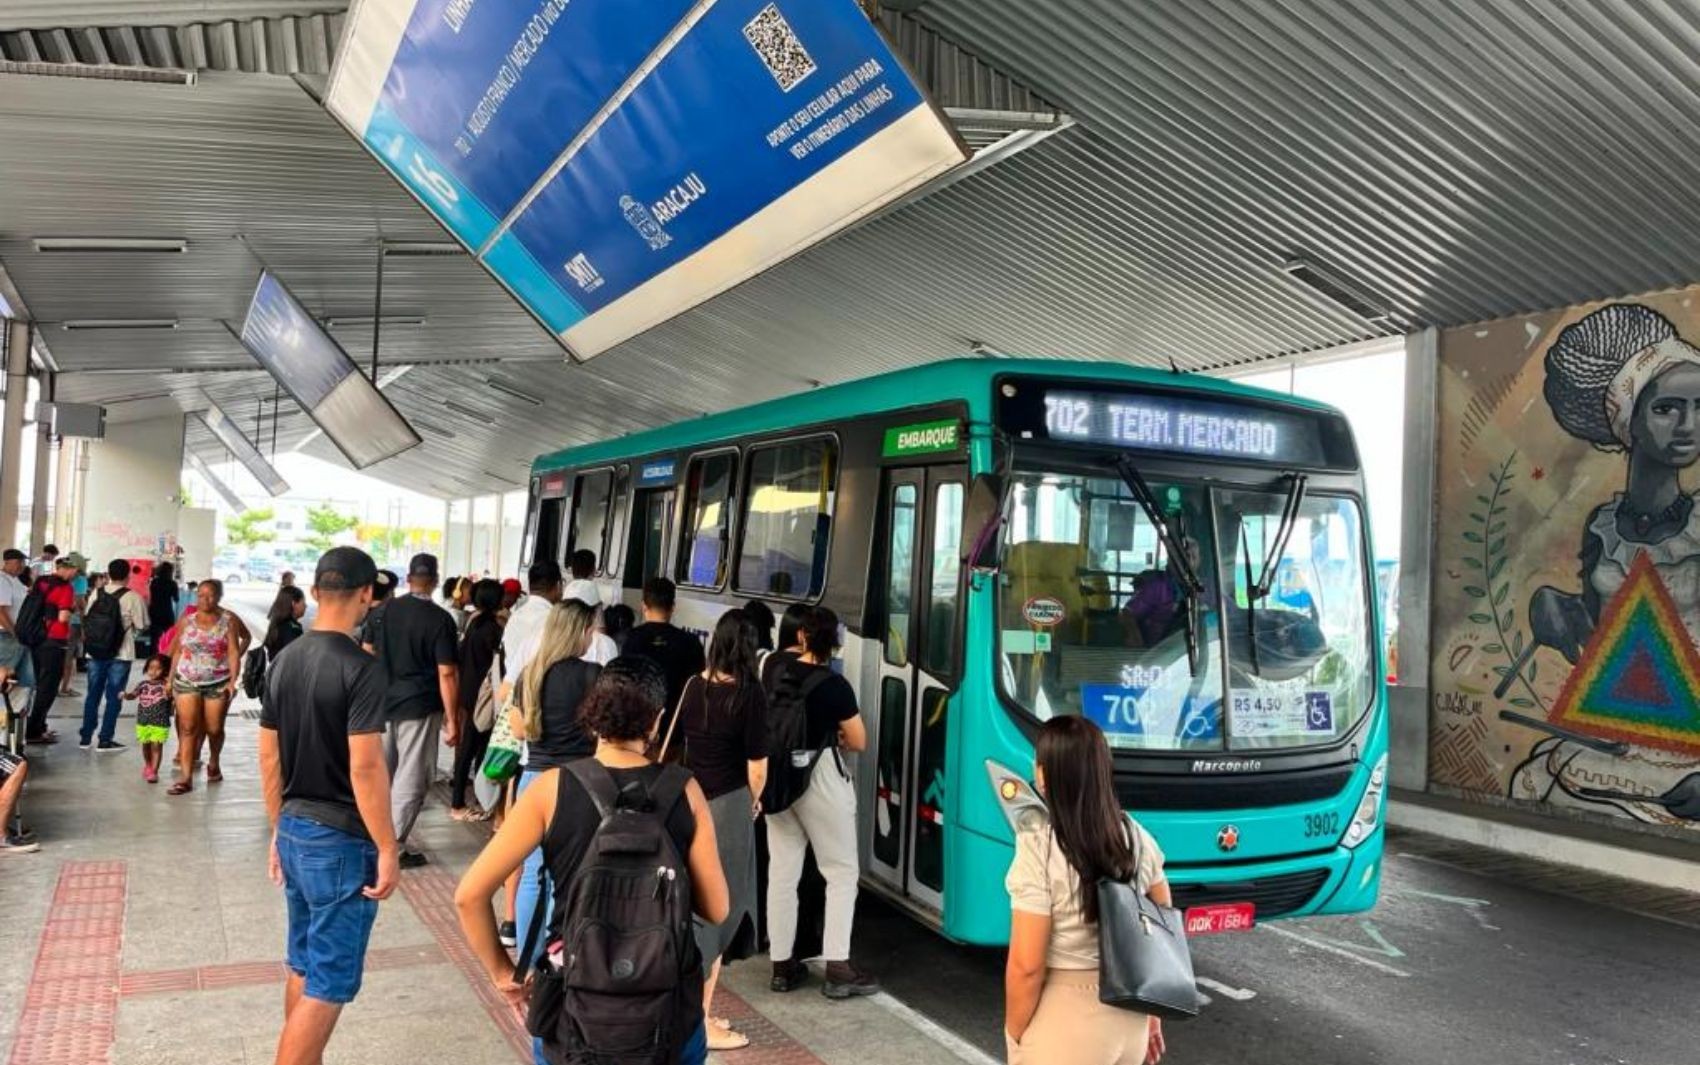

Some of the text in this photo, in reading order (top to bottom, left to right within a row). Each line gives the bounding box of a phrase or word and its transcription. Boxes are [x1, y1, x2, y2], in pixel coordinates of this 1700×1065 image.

[487, 65, 517, 106] FRANCO
[509, 14, 549, 71] MERCADO
[794, 107, 813, 128] SEU
[806, 87, 842, 119] CELULAR
[836, 73, 860, 98] AQUI
[854, 58, 884, 85] PARA
[844, 103, 866, 124] DAS
[859, 83, 894, 114] LINHAS
[408, 151, 459, 210] 16
[651, 171, 707, 226] ARACAJU
[897, 425, 957, 448] EMBARQUE
[1044, 396, 1090, 435] 702
[1178, 412, 1278, 455] MERCADO
[1254, 697, 1282, 712] 4,50
[1192, 760, 1261, 772] Marcopolo
[1304, 812, 1339, 838] 3902
